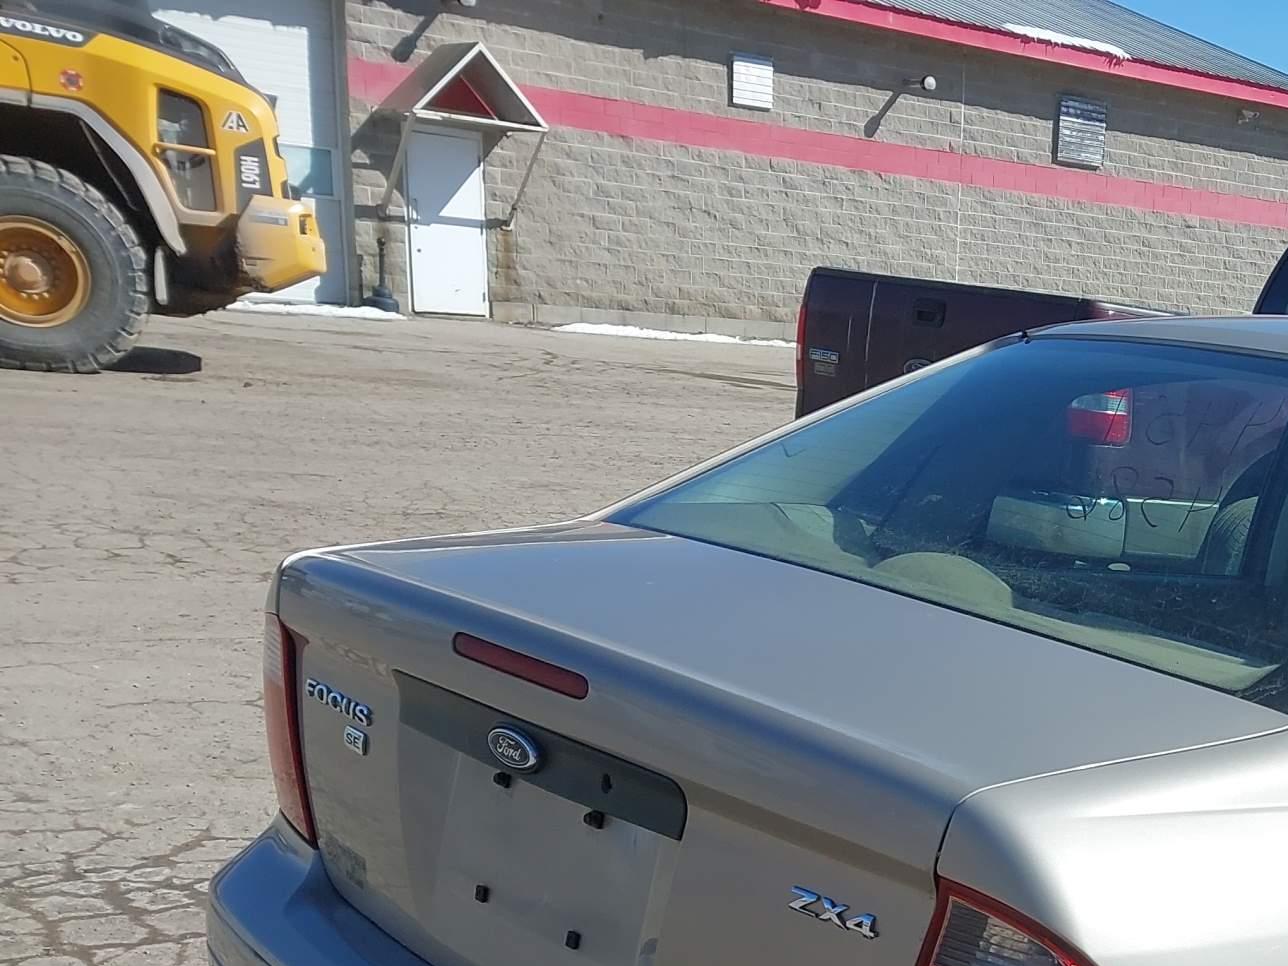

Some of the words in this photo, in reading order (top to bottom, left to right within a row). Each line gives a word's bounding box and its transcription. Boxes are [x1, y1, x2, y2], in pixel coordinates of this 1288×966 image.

[0, 16, 83, 42] VOLVO
[240, 155, 261, 189] L90H
[305, 678, 373, 728] FOCUS
[345, 731, 362, 750] SE
[496, 736, 522, 761] Ford
[788, 886, 879, 939] ZX4
